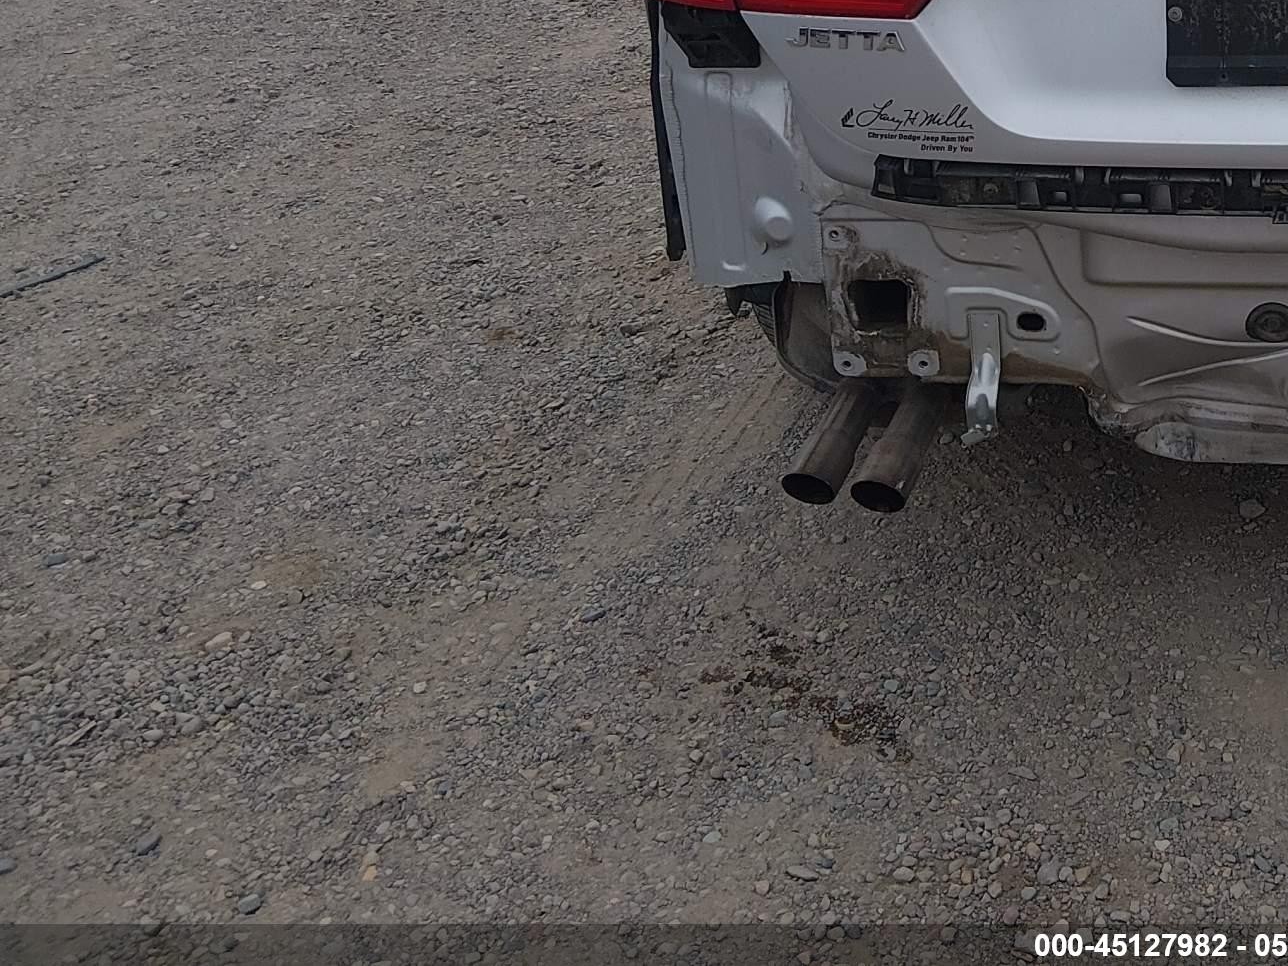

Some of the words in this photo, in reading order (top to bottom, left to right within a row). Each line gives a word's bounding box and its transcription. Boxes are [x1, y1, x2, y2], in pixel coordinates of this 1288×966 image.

[784, 26, 904, 52] JETTA
[903, 109, 920, 127] H
[919, 103, 974, 130] Miller
[867, 132, 898, 140] Chrysler
[898, 133, 921, 141] Dodge
[920, 144, 946, 152] Driven
[947, 145, 958, 153] By
[959, 145, 974, 153] You
